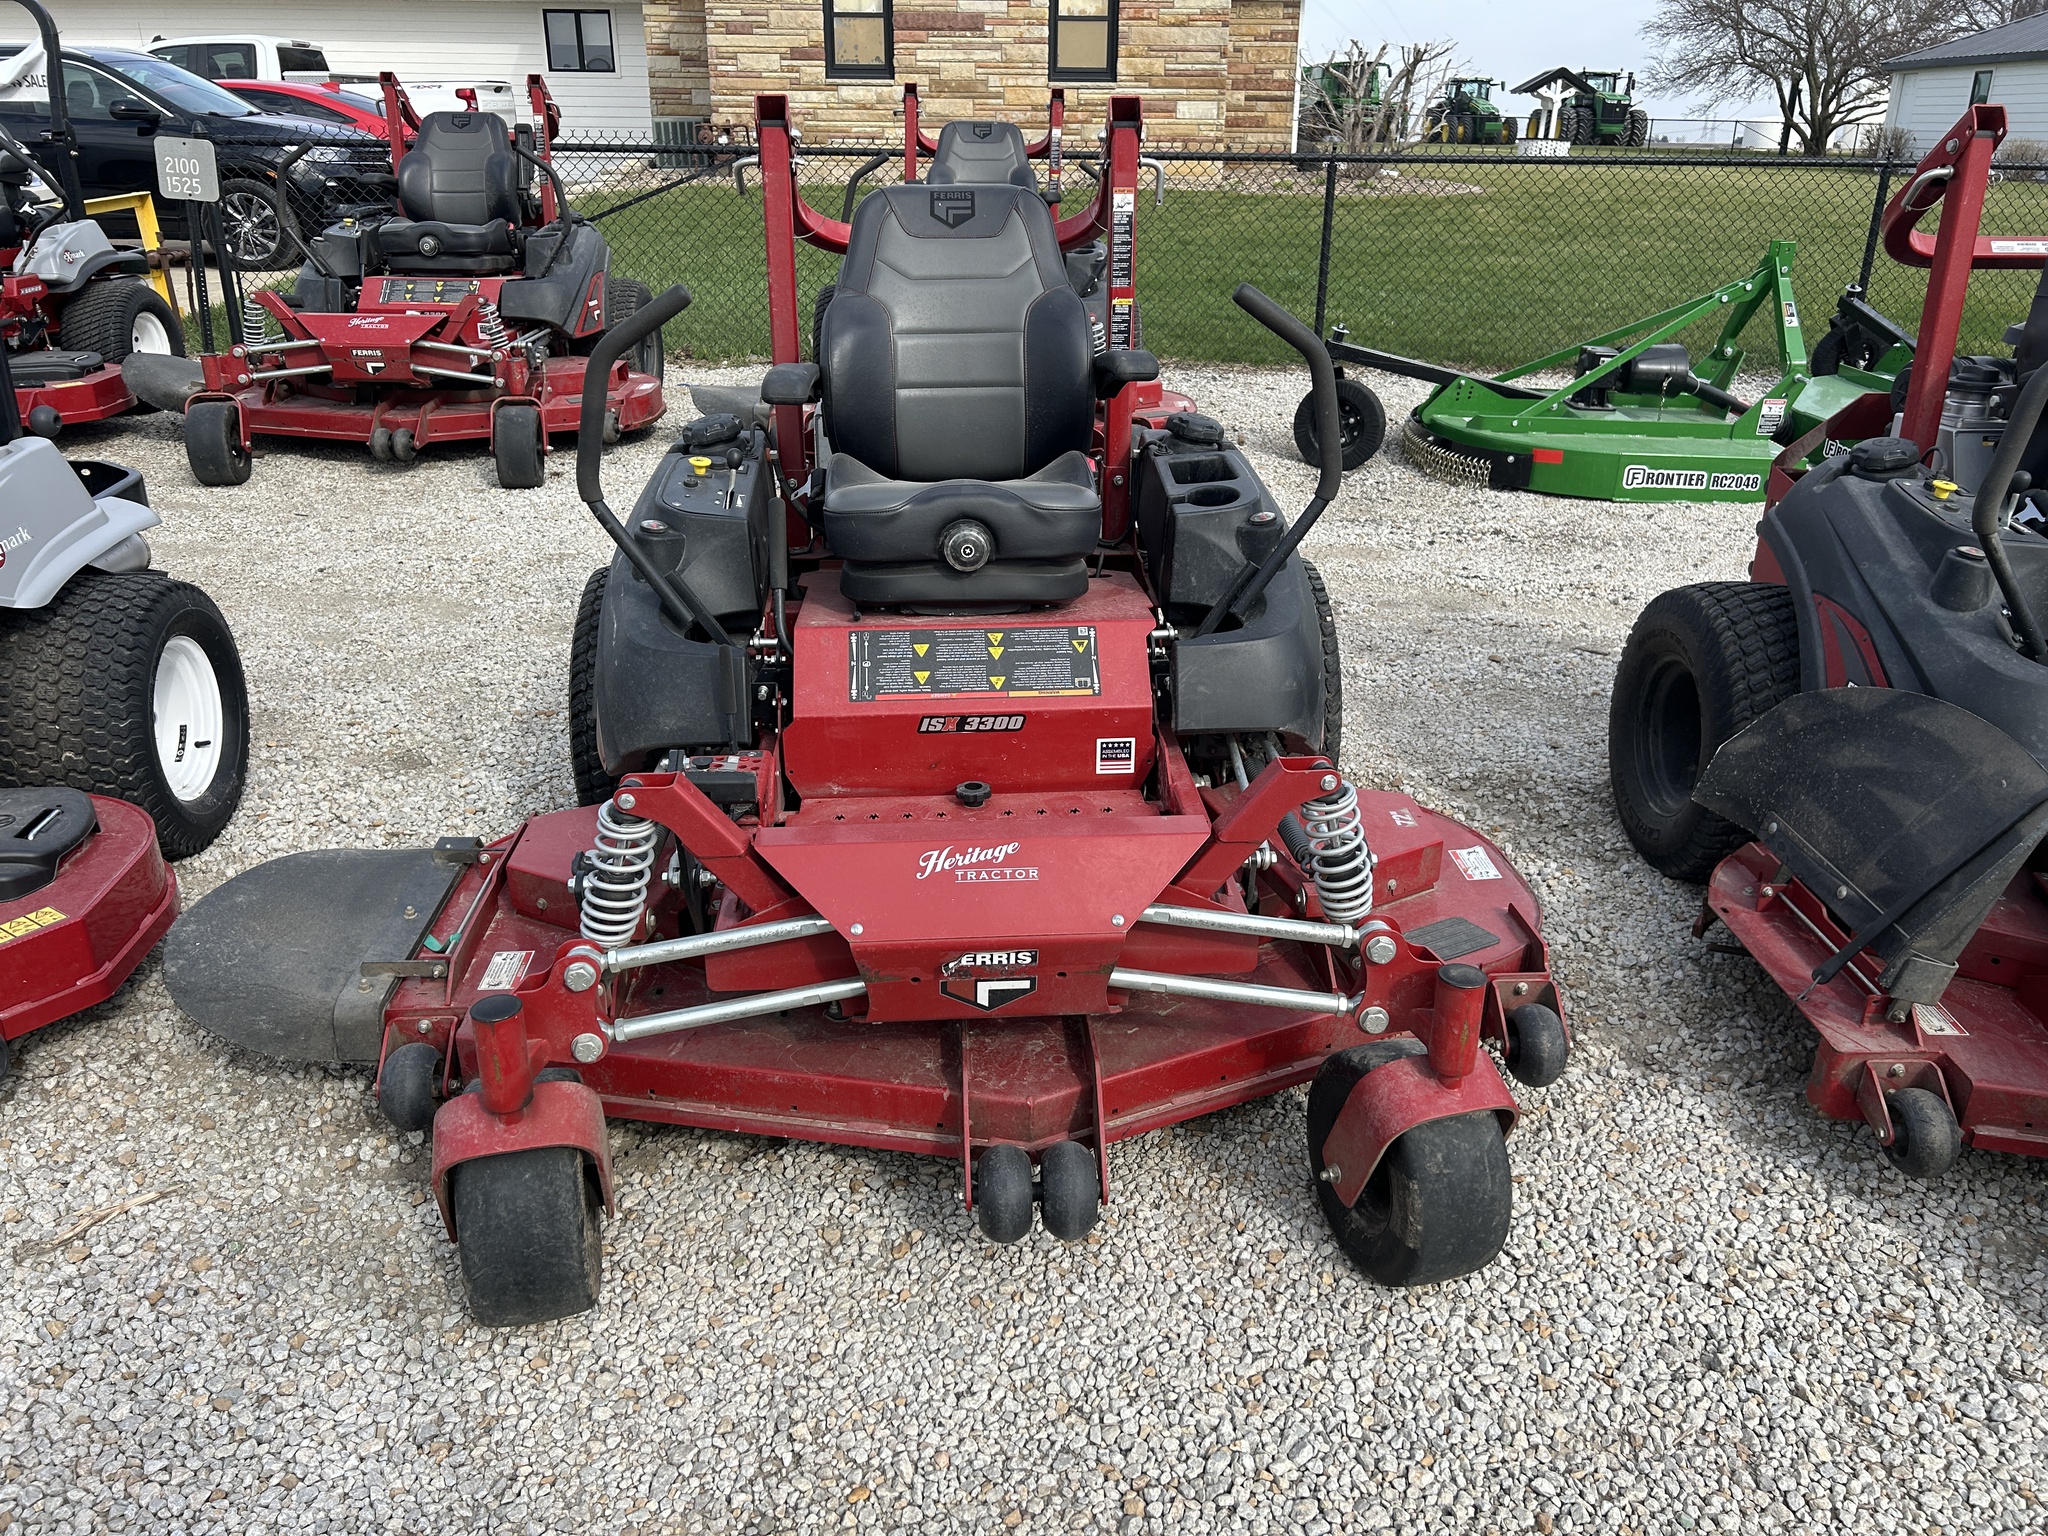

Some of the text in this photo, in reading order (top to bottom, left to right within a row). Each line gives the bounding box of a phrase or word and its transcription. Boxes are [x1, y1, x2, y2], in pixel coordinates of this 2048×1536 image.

[22, 74, 47, 88] SALE
[164, 156, 200, 175] 2100
[166, 176, 202, 195] 1525
[933, 191, 972, 200] FERRIS
[347, 316, 385, 328] Heritage
[351, 349, 382, 357] FERRIS
[1626, 467, 1760, 489] FRONTIER RC2048
[920, 715, 1025, 732] ISX 3300
[916, 841, 1021, 880] Heritage
[955, 869, 1038, 881] TRACTOR
[948, 952, 1032, 968] ERRIS
